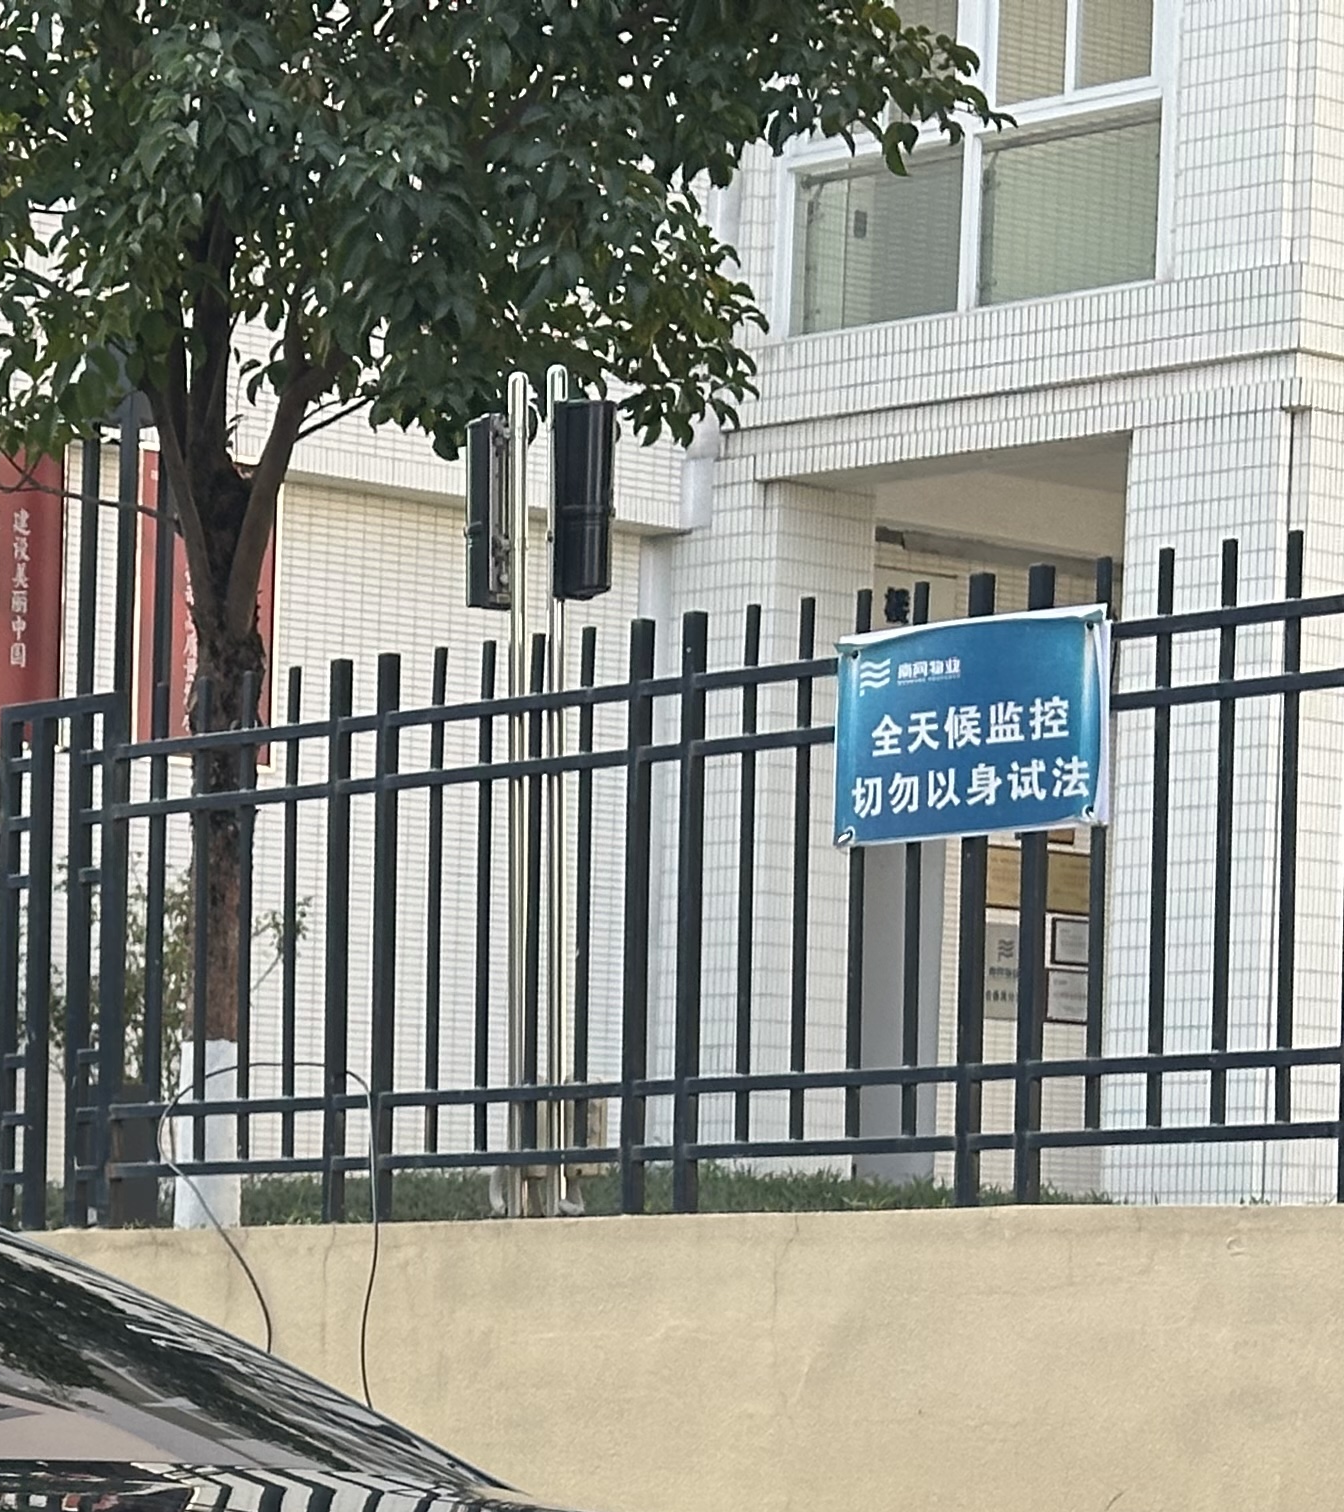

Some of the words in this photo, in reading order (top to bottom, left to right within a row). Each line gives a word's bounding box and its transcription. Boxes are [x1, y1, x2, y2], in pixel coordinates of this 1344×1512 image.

[871, 695, 1070, 758] 全天候监控
[851, 755, 1091, 819] 切勿以身试法
